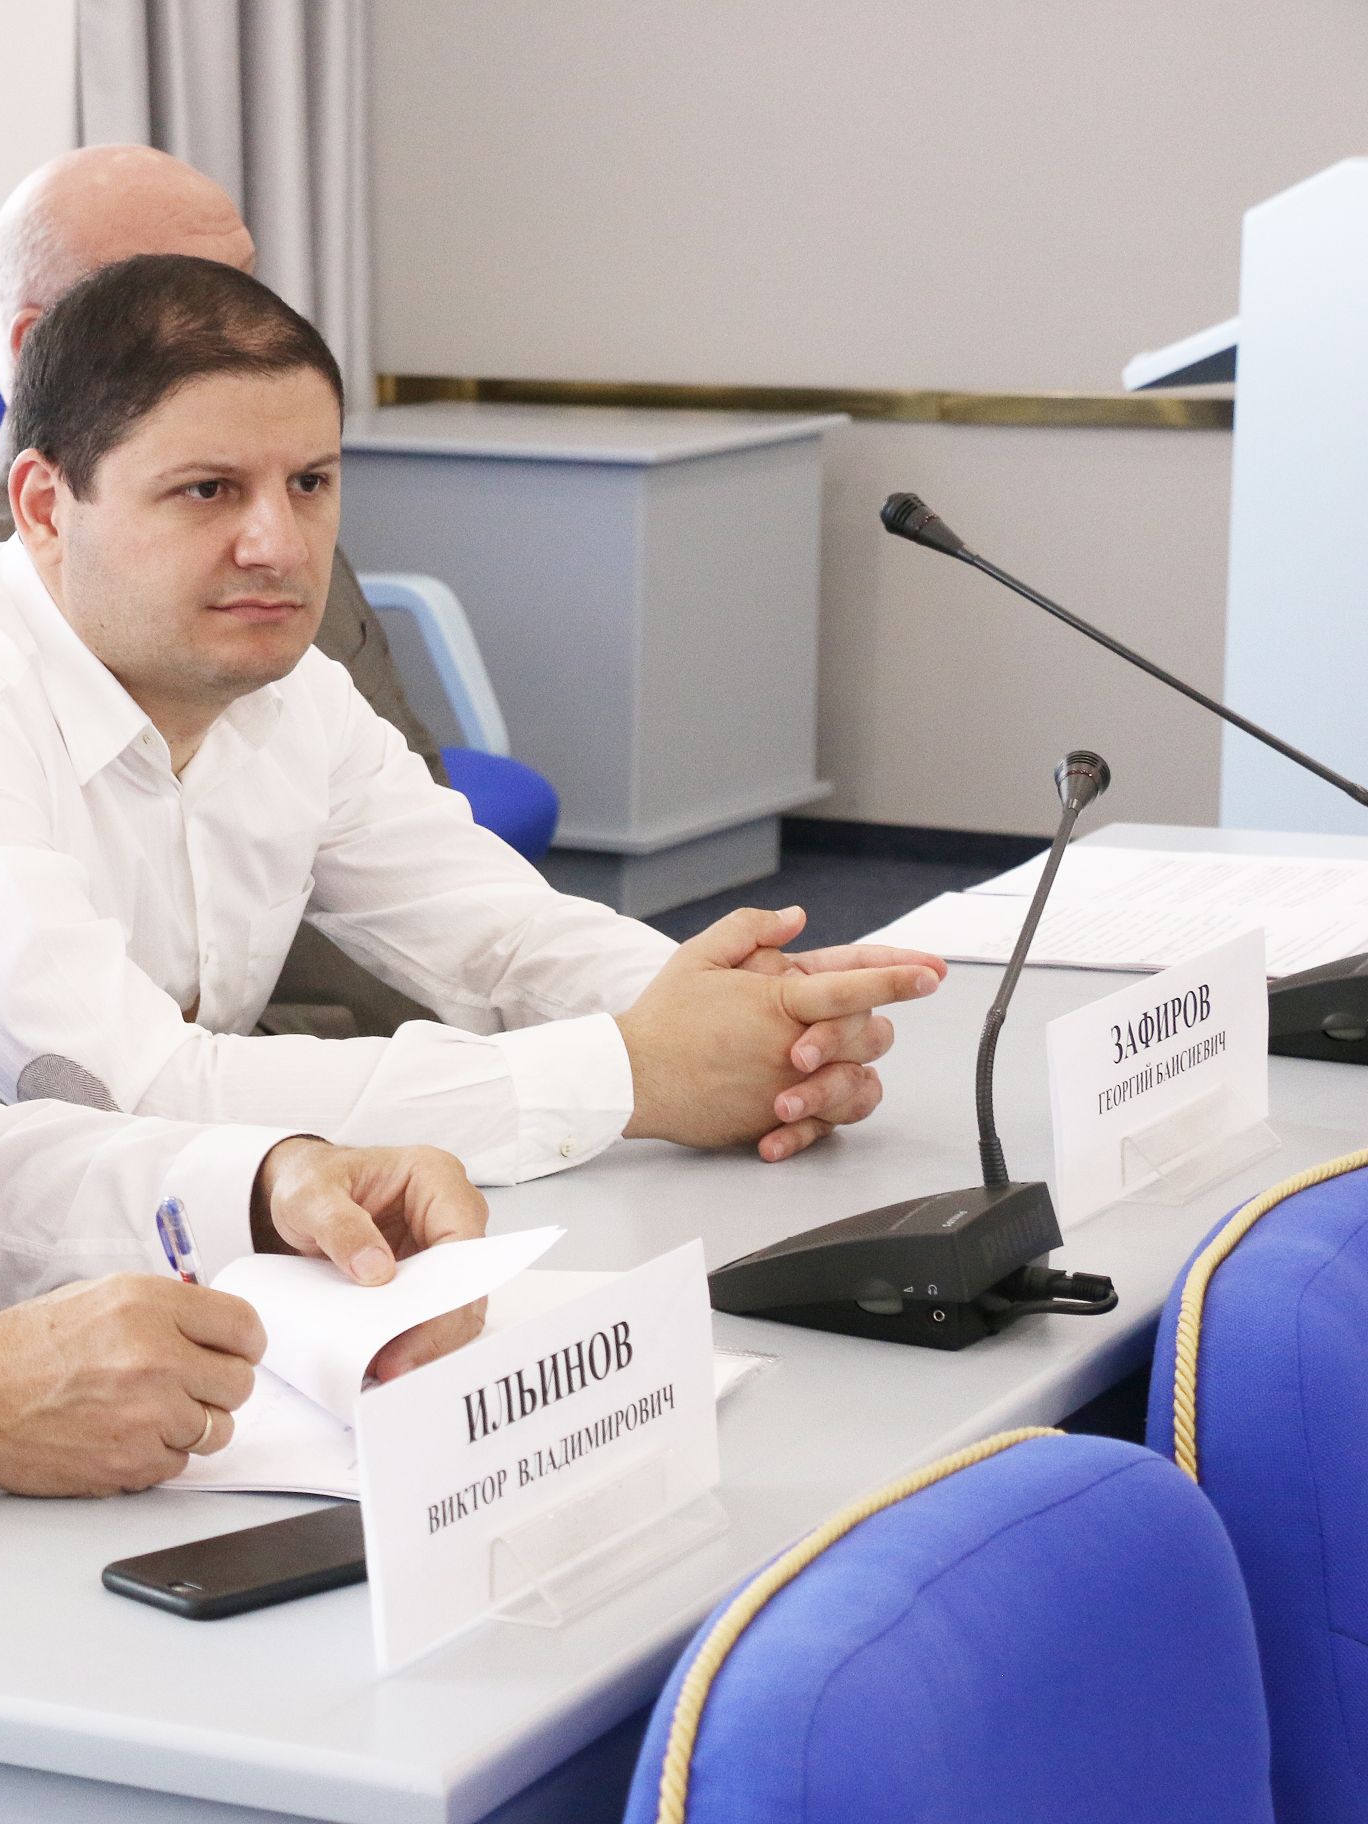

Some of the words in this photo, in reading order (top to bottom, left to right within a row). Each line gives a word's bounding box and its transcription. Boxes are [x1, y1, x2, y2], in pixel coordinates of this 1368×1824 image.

[1111, 984, 1211, 1064] ЗАФИРОВ
[1098, 1062, 1154, 1115] ГЕОРГИЙ
[463, 1320, 633, 1444] ИЛЬИНОВ
[428, 1468, 508, 1536] ВИКТОР
[517, 1384, 675, 1487] ВЛАДИМИРОВИЧ
